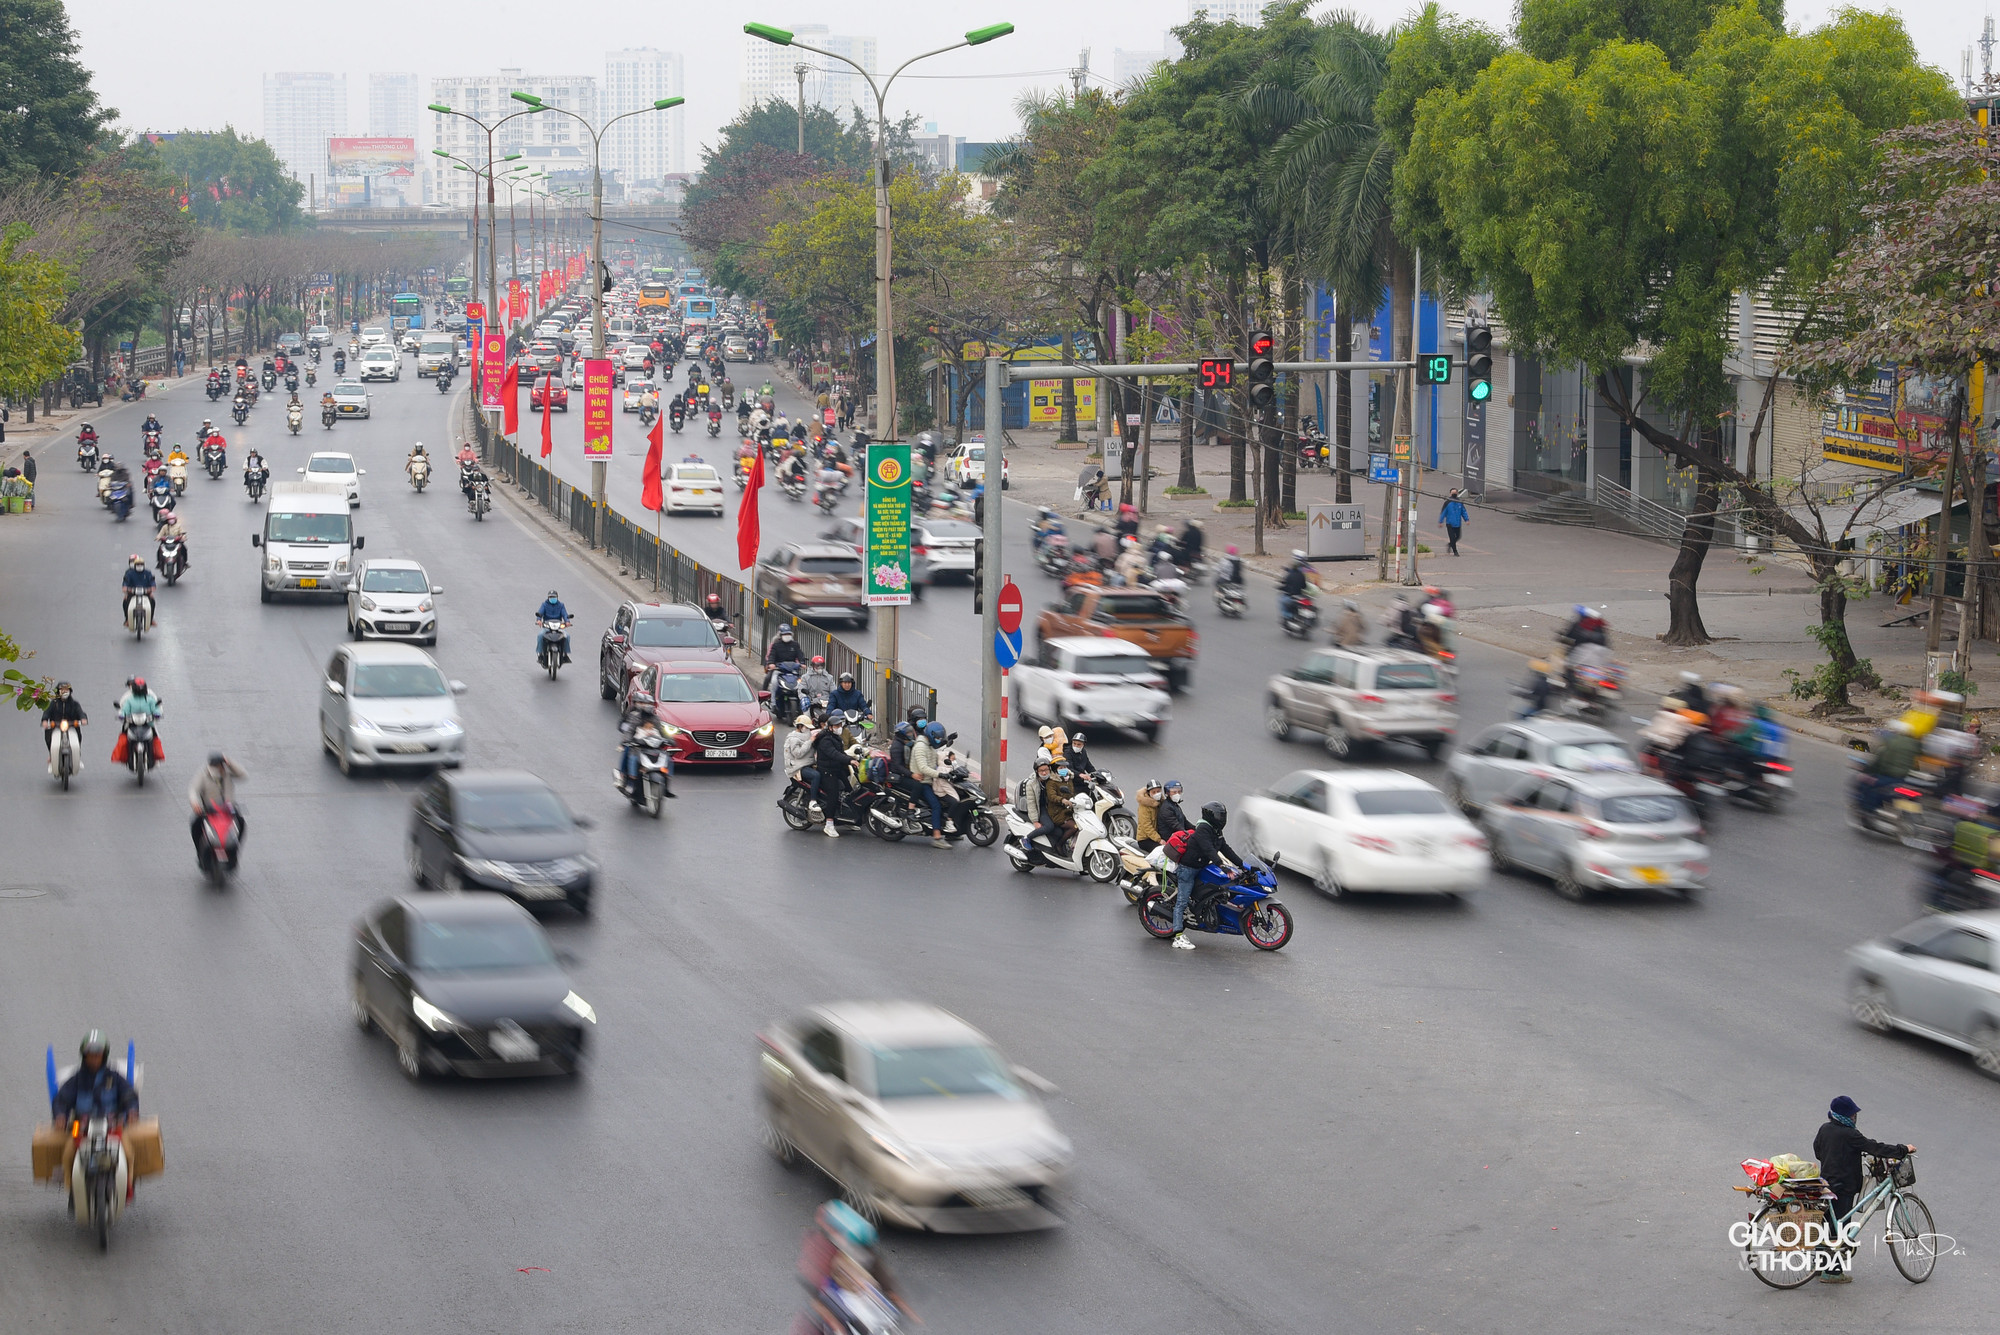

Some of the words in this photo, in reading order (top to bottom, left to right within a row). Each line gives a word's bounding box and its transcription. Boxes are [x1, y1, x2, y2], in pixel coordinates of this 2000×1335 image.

[1202, 361, 1230, 386] 54
[1429, 357, 1448, 382] 19
[589, 374, 608, 384] CHÚC
[589, 386, 609, 395] MỪNG
[591, 398, 606, 407] NĂM
[592, 410, 605, 418] MỚI
[1395, 441, 1410, 454] LỐP
[1350, 510, 1361, 520] RA
